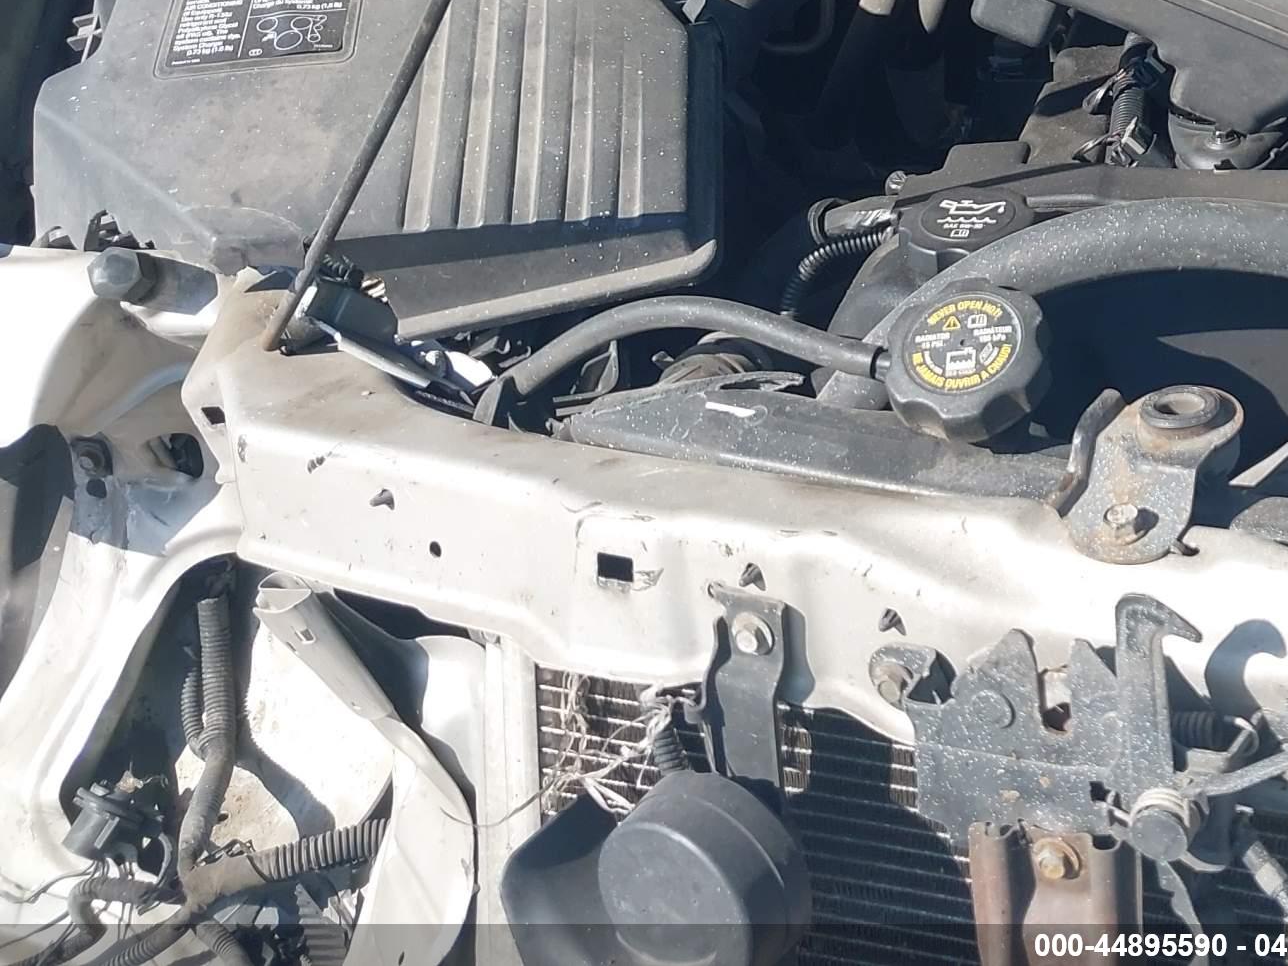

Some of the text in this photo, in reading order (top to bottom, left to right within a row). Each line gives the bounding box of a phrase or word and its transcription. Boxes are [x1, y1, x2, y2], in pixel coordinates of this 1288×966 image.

[927, 303, 957, 326] NEVER
[957, 300, 984, 311] OPEN
[944, 374, 981, 390] OUVRIR
